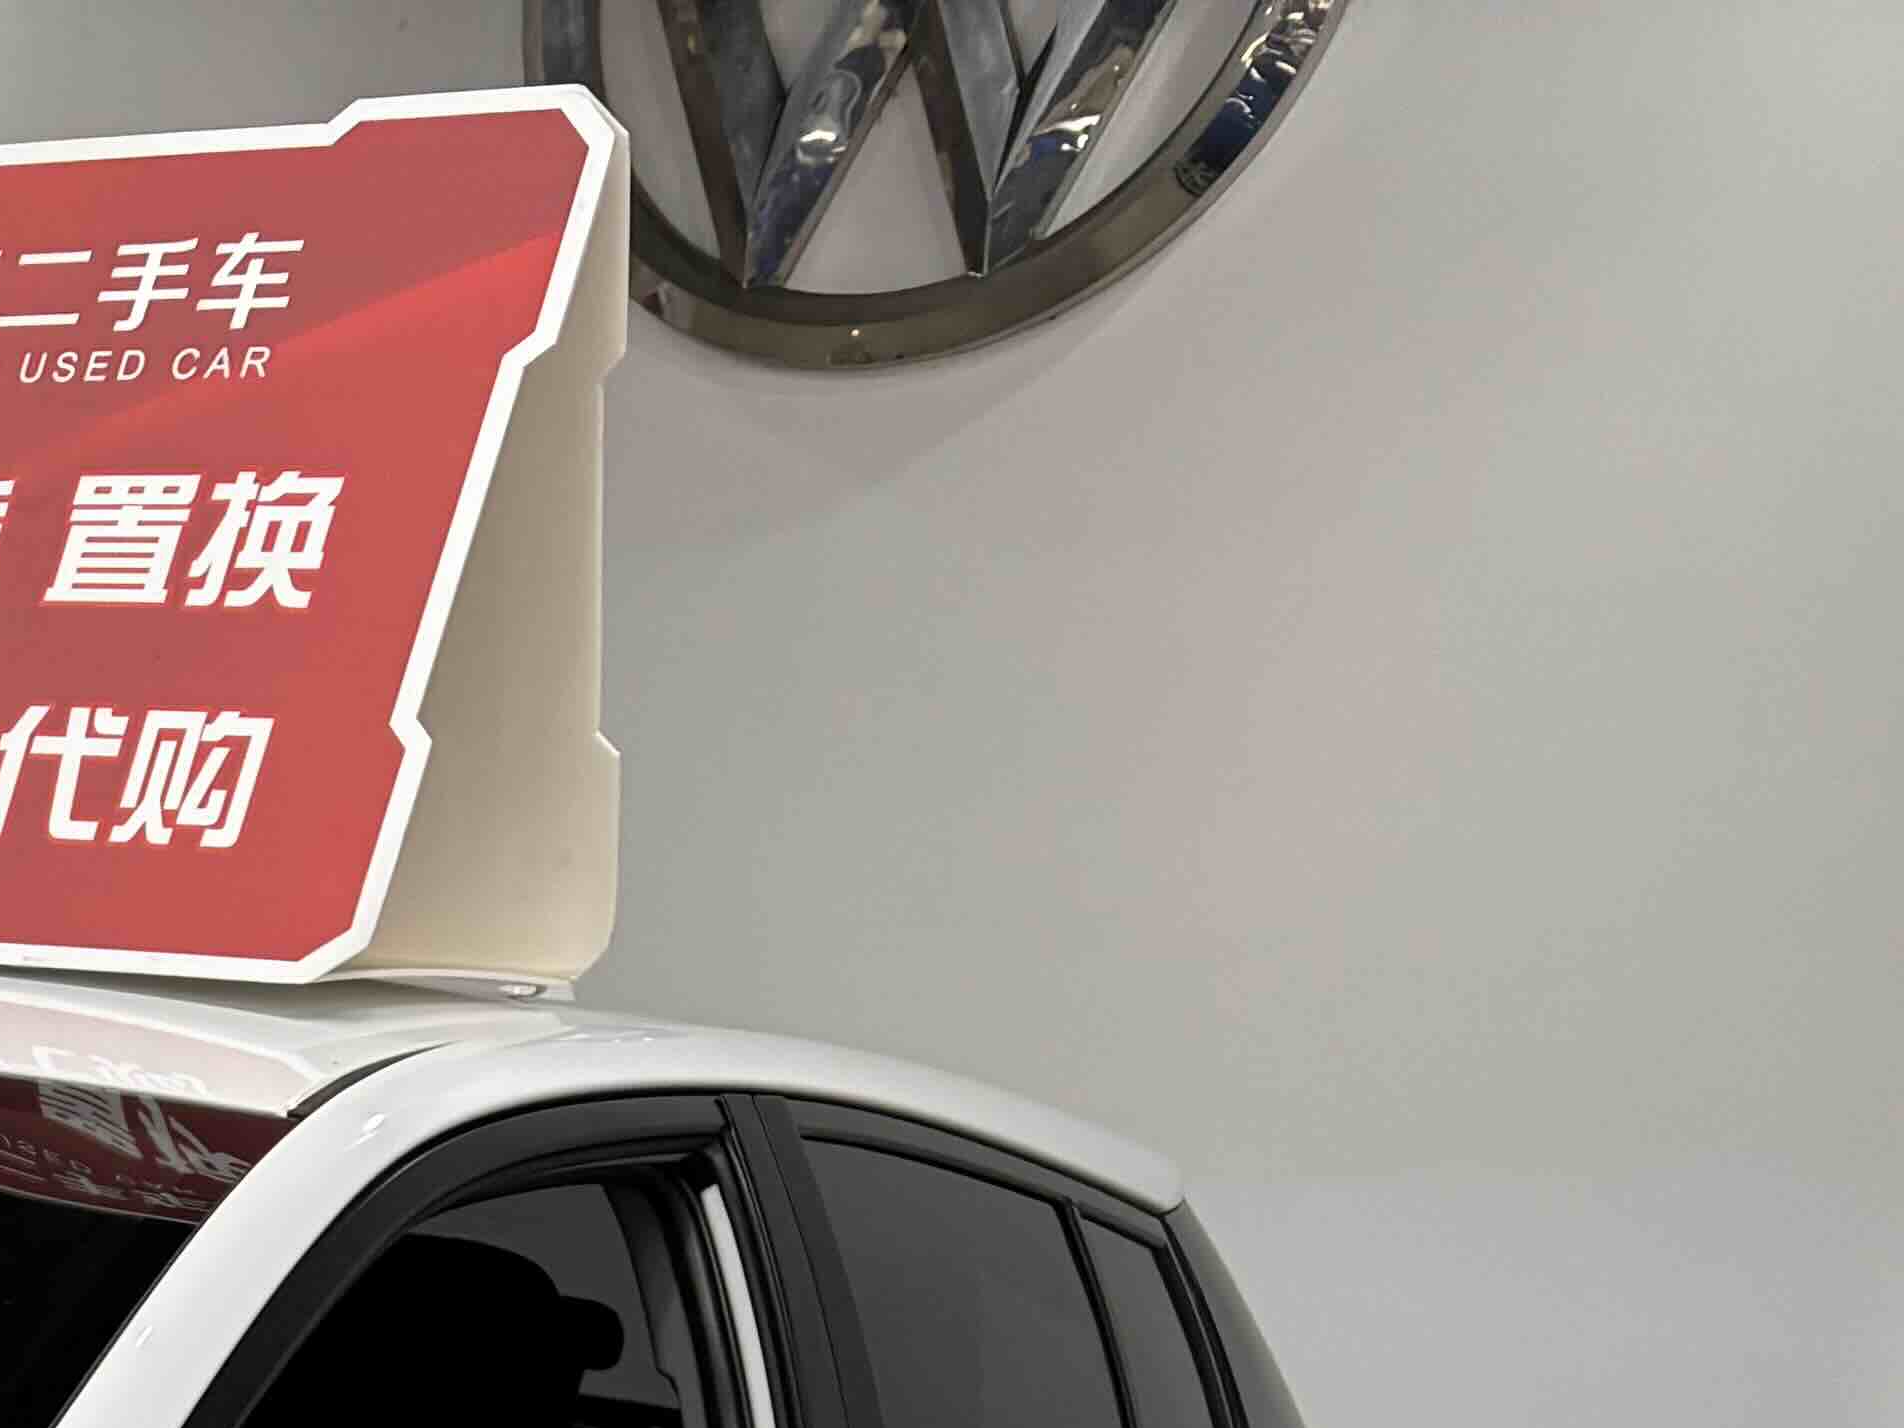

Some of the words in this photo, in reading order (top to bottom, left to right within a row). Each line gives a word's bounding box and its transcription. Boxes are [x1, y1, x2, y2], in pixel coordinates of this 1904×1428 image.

[19, 349, 145, 383] USED
[172, 346, 271, 380] CAR
[43, 471, 345, 609] 置换
